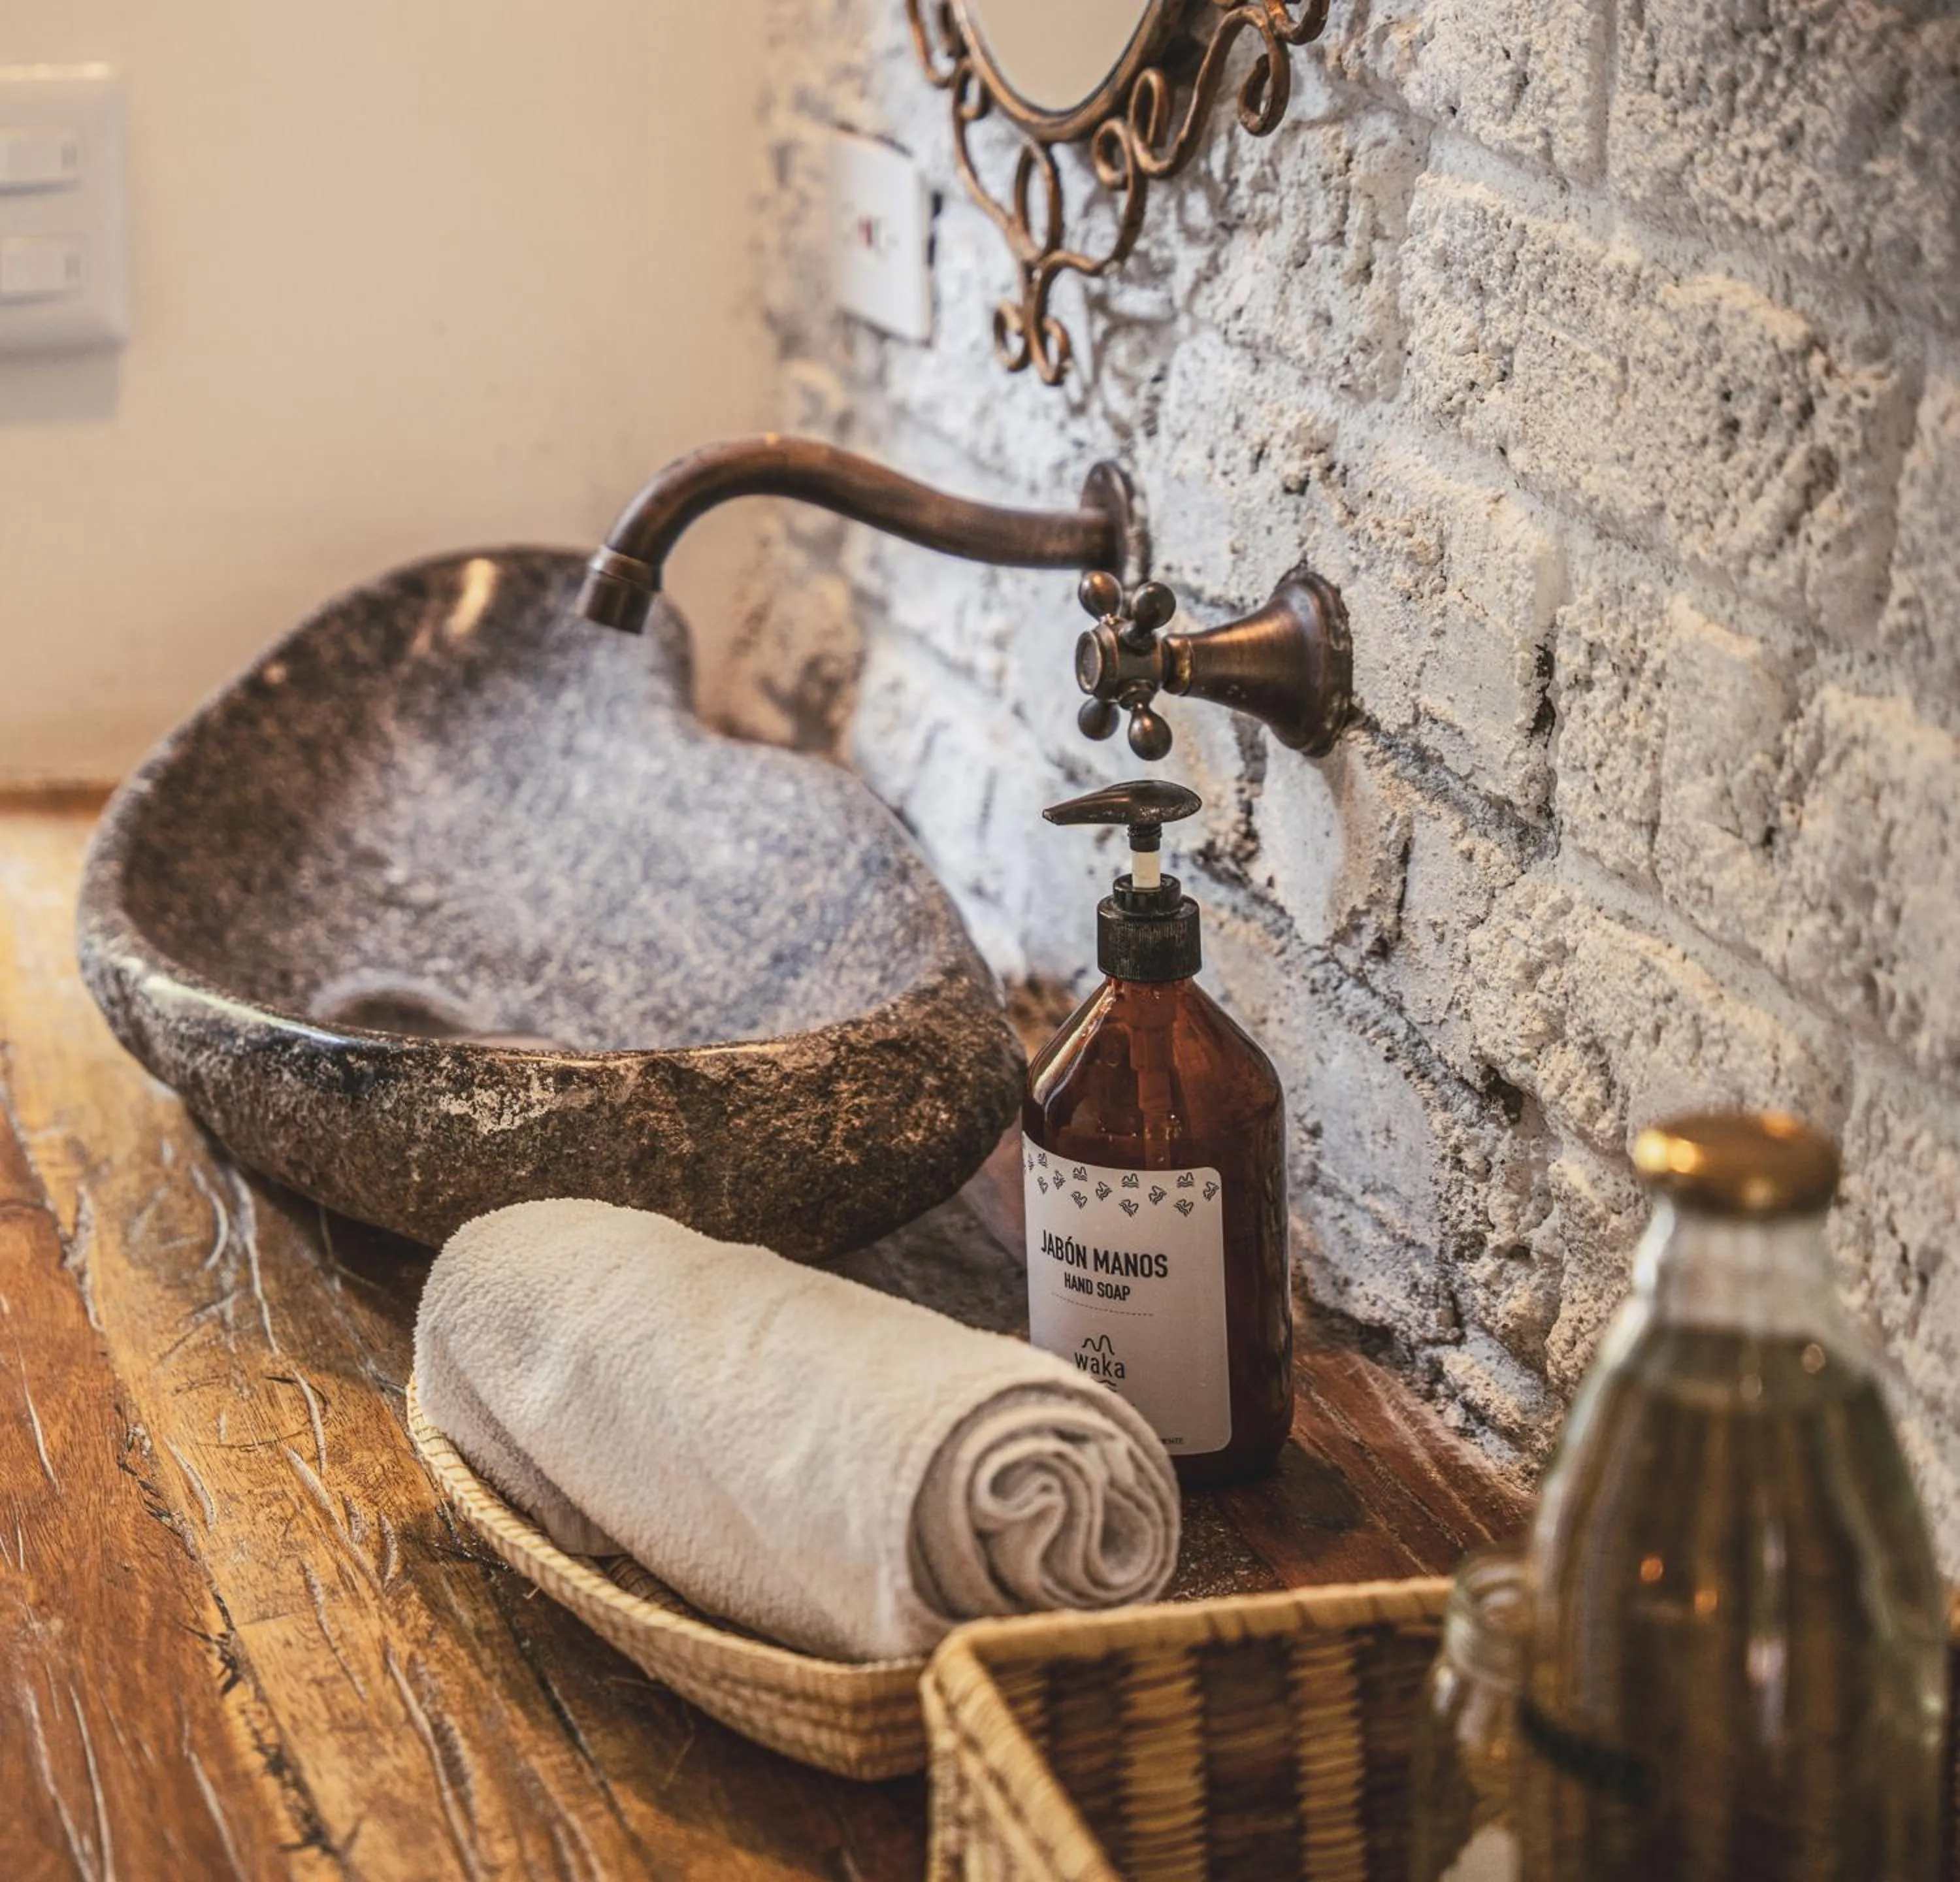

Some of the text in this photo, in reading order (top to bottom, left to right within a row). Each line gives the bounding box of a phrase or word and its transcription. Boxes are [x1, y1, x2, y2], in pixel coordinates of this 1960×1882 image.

[1041, 1230, 1168, 1278] JABÓN MANOS
[1064, 1272, 1131, 1300] HAND SOAP
[1075, 1353, 1125, 1379] waka
